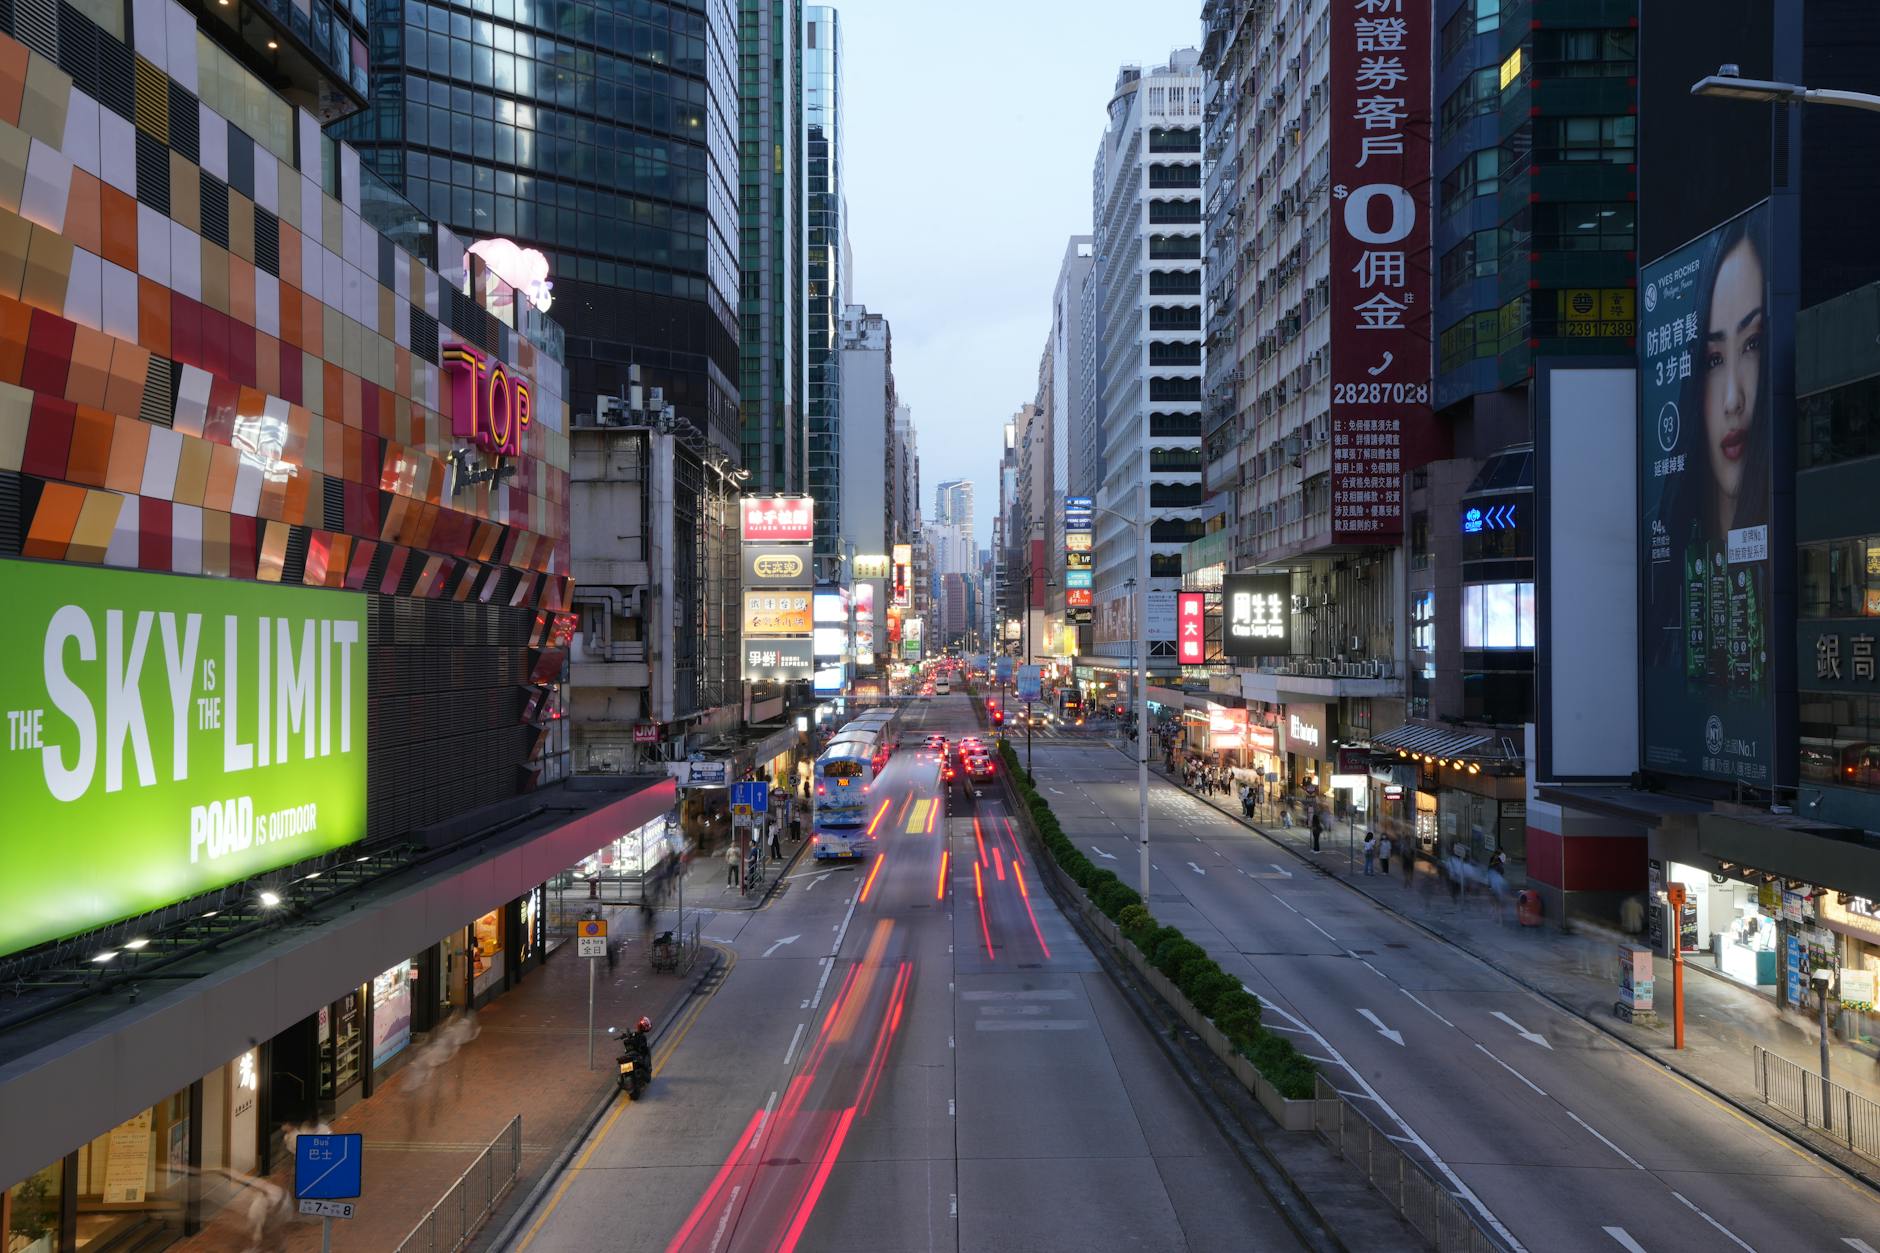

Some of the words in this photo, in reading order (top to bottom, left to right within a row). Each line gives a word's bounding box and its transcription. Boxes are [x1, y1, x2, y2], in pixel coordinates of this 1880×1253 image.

[1658, 273, 1673, 289] YVES
[1674, 259, 1700, 280] ROCHER
[1647, 311, 1699, 358] 防脫育髮
[1334, 383, 1428, 404] 28287028
[1663, 416, 1673, 434] 93
[203, 659, 216, 692] IS
[42, 605, 202, 802] SKY
[224, 615, 359, 773] LIMIT
[197, 697, 221, 731] THE
[7, 709, 44, 751] THE
[636, 725, 656, 736] JM
[190, 796, 253, 864] POAD
[255, 815, 267, 846] IS
[269, 802, 317, 843] OUTDOOR
[309, 1149, 332, 1160] 巴士
[313, 1138, 329, 1146] Bus
[344, 1206, 351, 1216] 8
